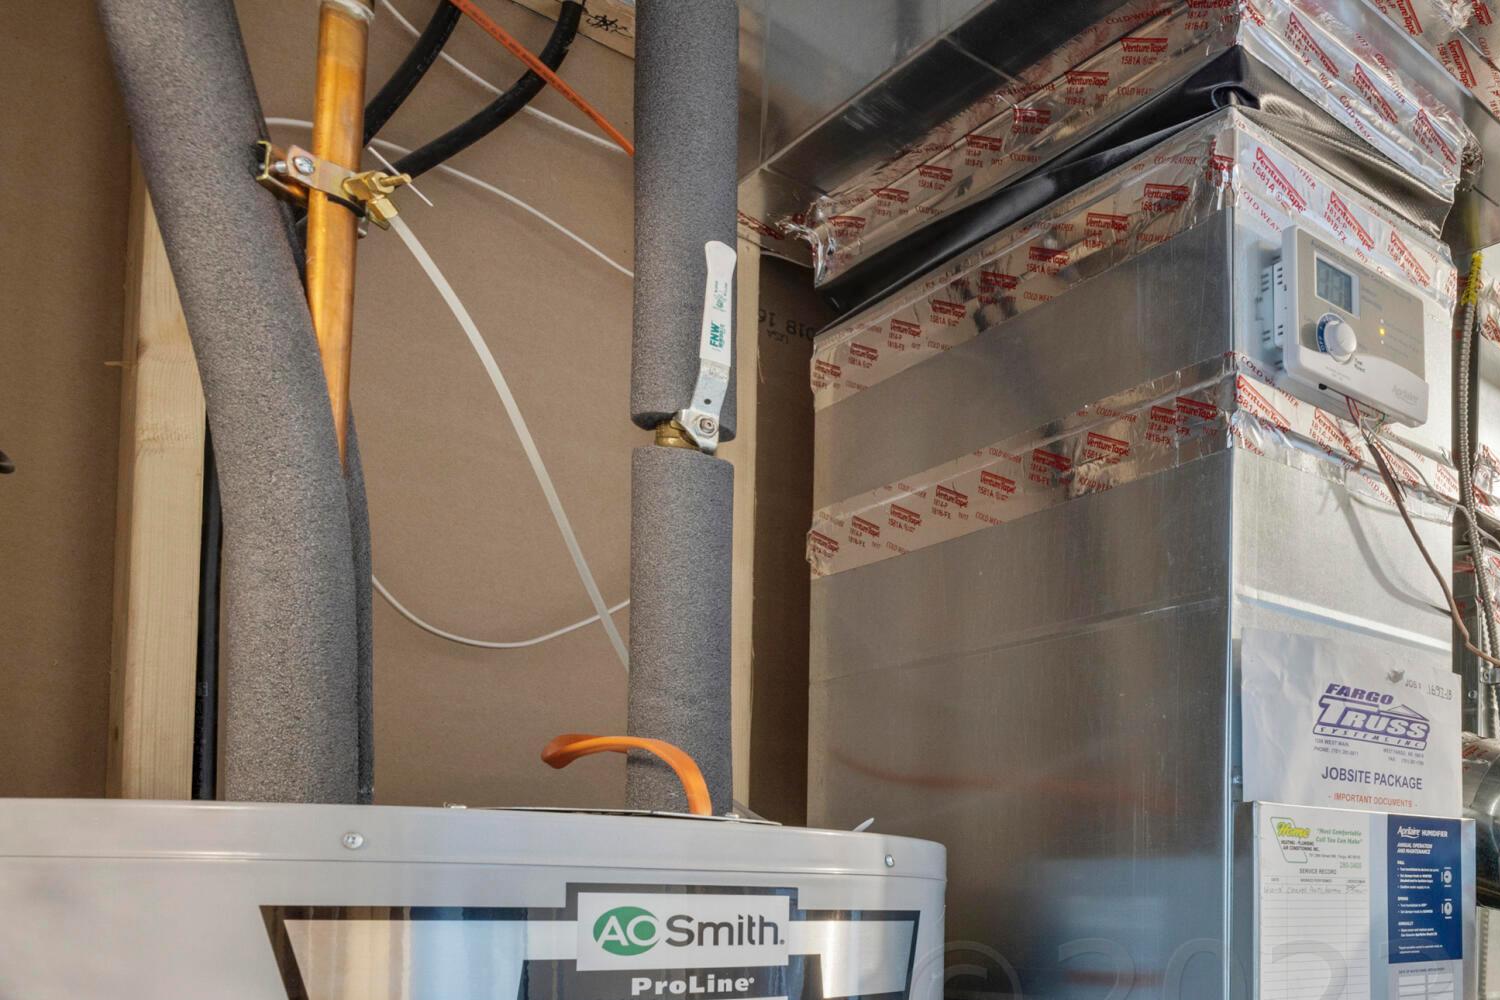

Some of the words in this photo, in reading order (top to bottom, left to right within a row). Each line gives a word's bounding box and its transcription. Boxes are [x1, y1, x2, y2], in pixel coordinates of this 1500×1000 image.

[1255, 150, 1307, 213] VentureTape
[1330, 194, 1376, 251] VentureTape
[709, 320, 720, 348] FNW
[1236, 378, 1290, 433] VentureTape
[1326, 683, 1394, 705] FARGO
[1319, 695, 1429, 739] TRUSS
[1321, 766, 1371, 784] JOBSITE
[1374, 772, 1423, 790] PACKAGE
[1334, 793, 1372, 805] IMPORTANT
[1374, 796, 1412, 808] DOCUMENTS
[631, 974, 750, 996] ProLine
